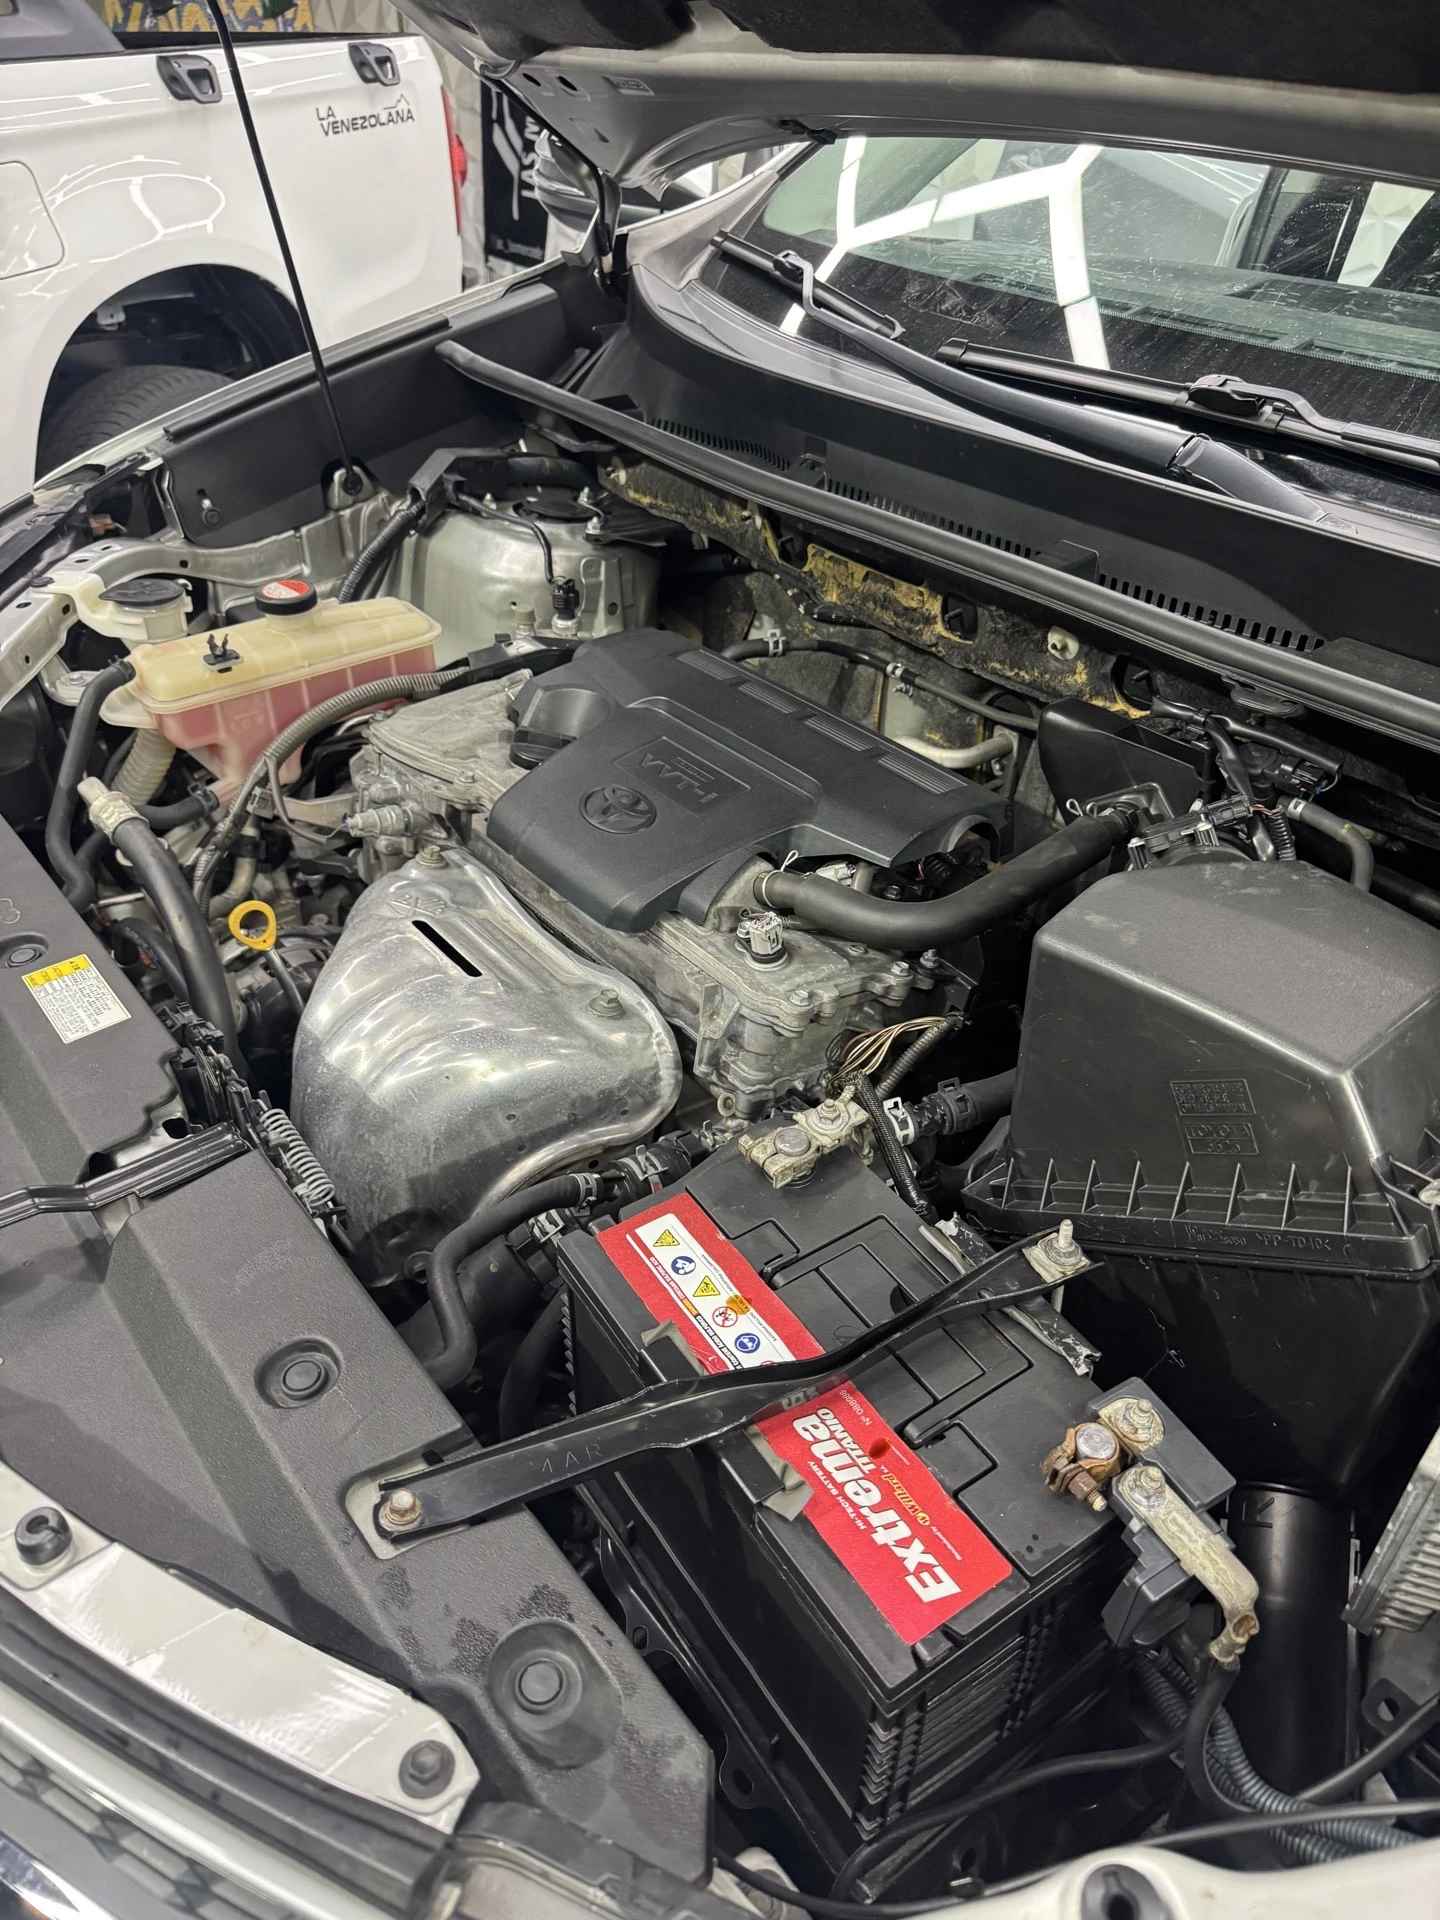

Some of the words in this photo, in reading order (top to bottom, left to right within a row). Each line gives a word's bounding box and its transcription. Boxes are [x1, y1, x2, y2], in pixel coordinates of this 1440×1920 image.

[316, 105, 337, 121] LA
[320, 108, 415, 137] VENEZOLANA
[1188, 1124, 1252, 1138] TOYOTA
[816, 1407, 877, 1474] TITANIO
[806, 1460, 839, 1494] BATTERY
[880, 1471, 921, 1514] Willard
[790, 1411, 962, 1602] Extrema
[835, 1496, 868, 1528] HI-TECH
